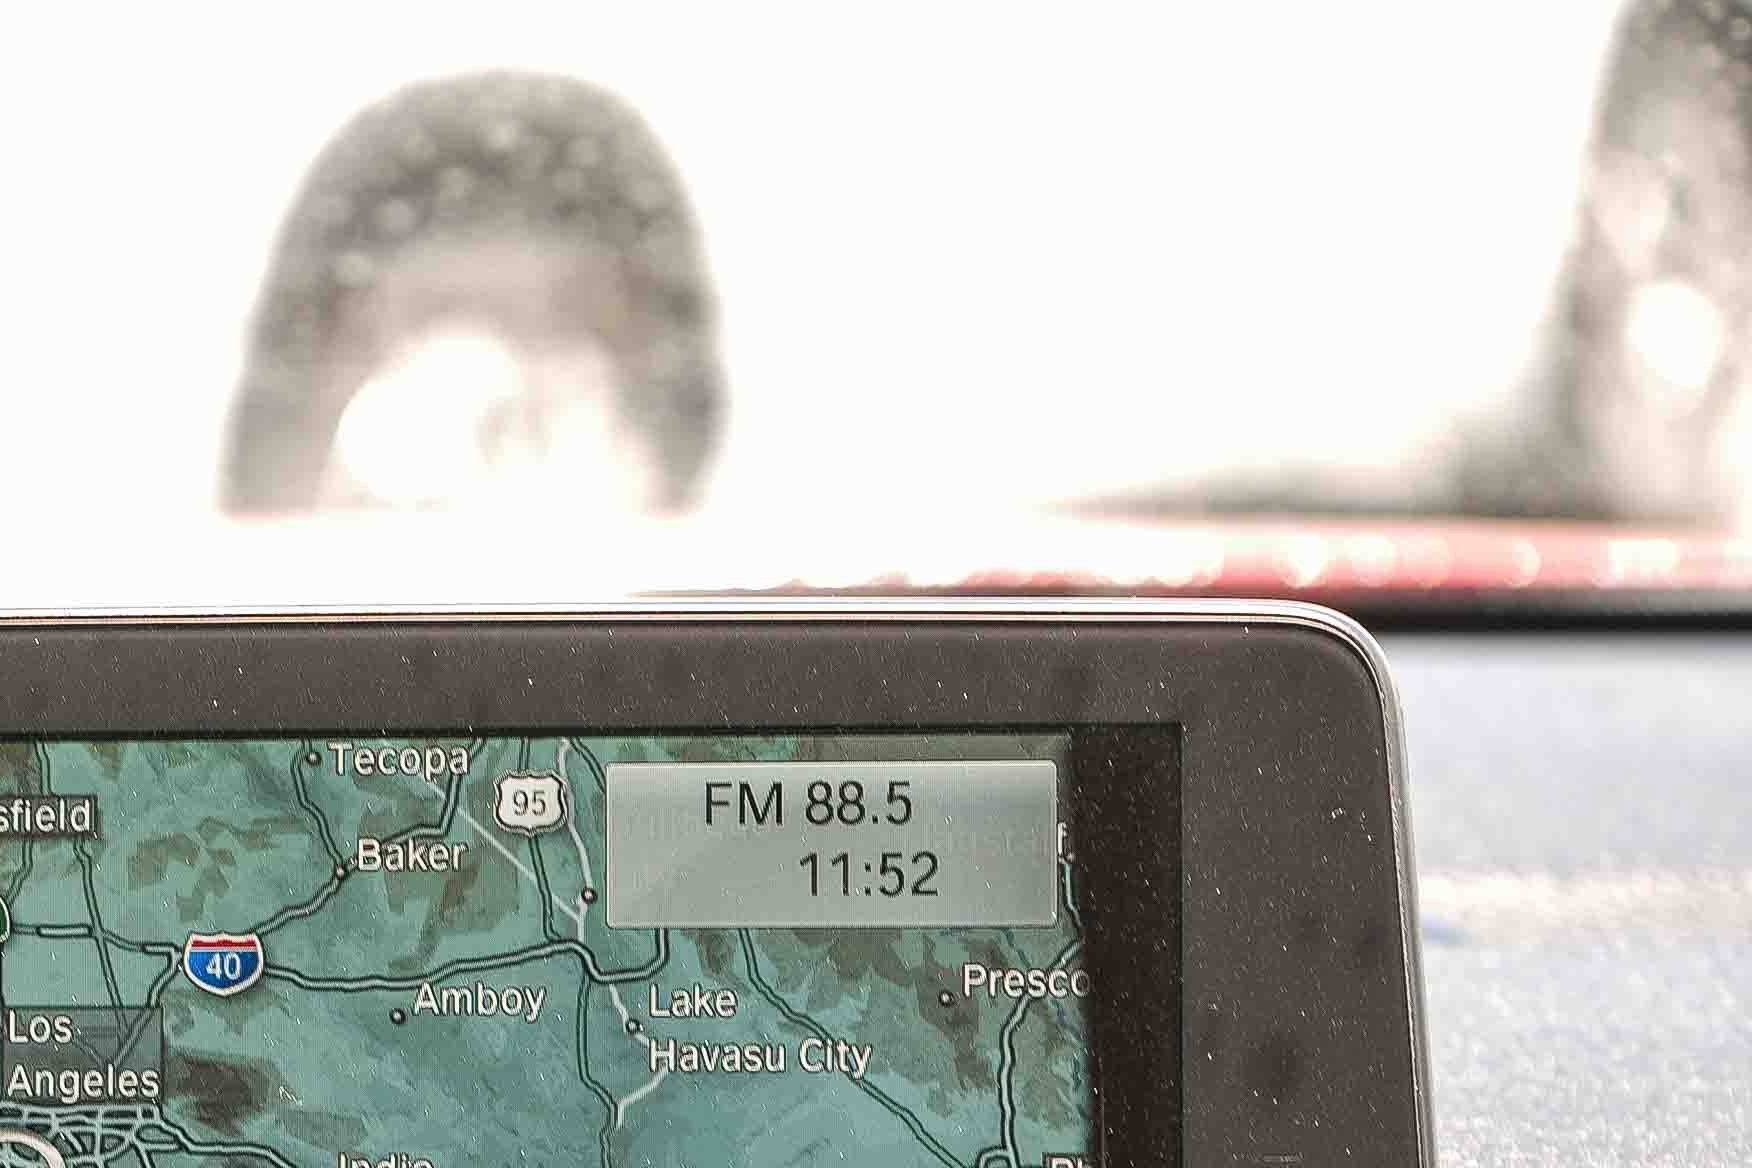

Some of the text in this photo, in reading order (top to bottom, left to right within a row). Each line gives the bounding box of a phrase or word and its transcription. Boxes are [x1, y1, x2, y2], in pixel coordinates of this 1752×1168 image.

[328, 742, 470, 781] Tecopa
[511, 789, 548, 816] 95
[704, 780, 914, 826] FM 88.5
[357, 838, 465, 872] Baker
[799, 851, 940, 897] 11:52
[205, 952, 241, 981] 40
[413, 982, 546, 1022] Amboy
[649, 984, 738, 1018] Lake
[8, 1010, 73, 1044] Los
[649, 1038, 872, 1079] Havasu City
[6, 1064, 160, 1101] Angeles
